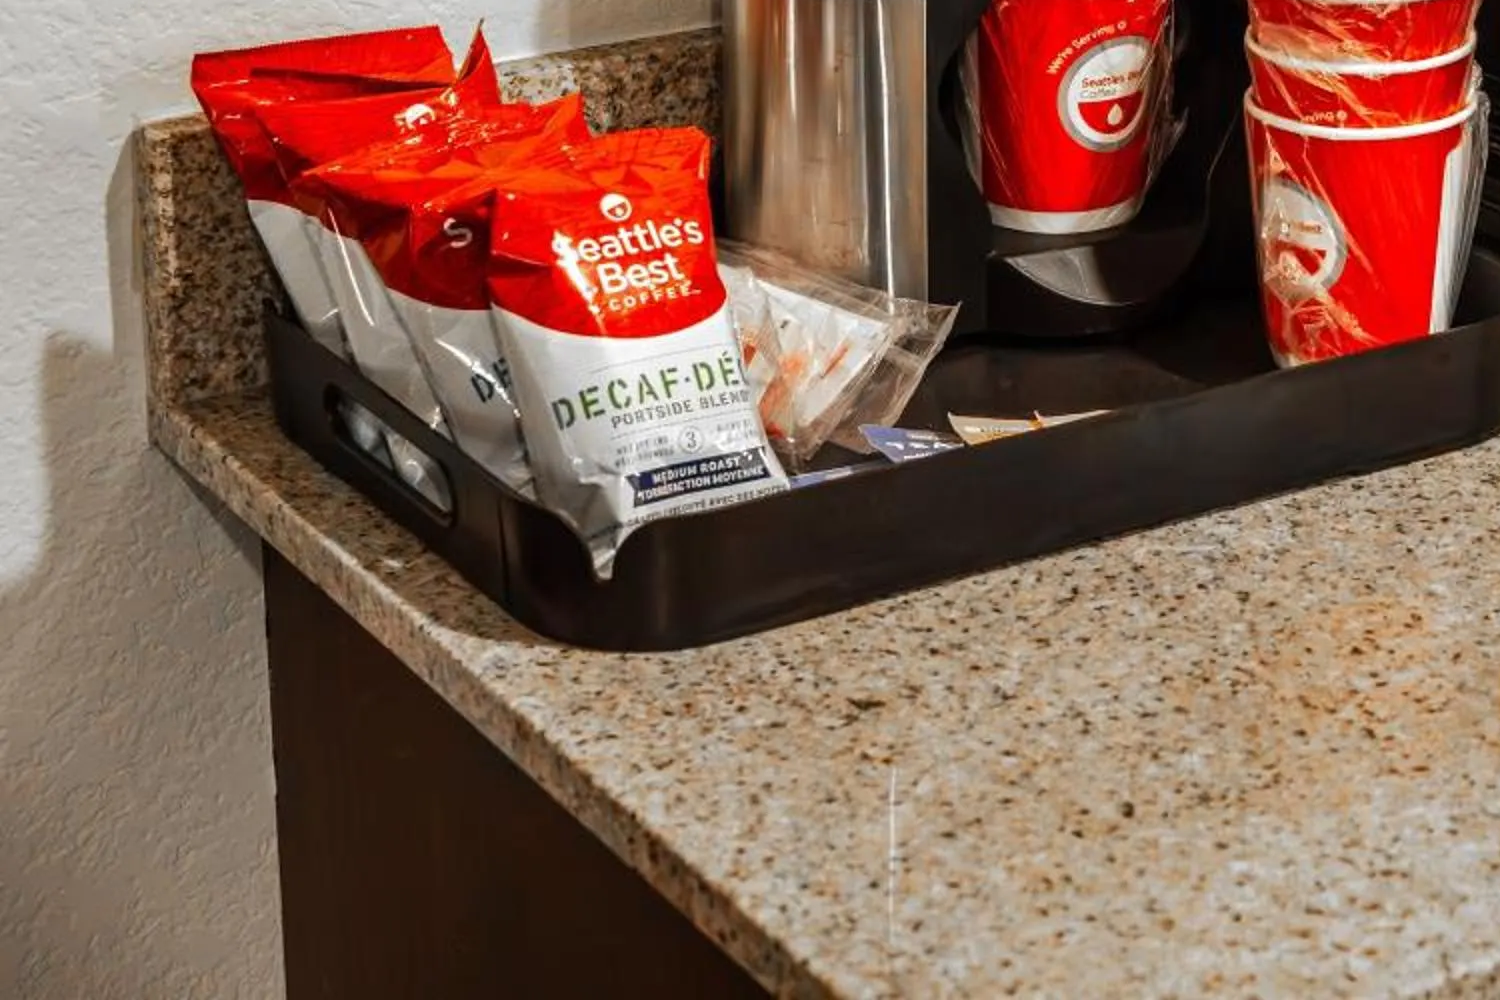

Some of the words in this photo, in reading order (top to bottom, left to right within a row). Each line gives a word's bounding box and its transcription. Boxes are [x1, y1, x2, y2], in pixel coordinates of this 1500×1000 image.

[597, 252, 686, 295] Best
[608, 279, 693, 311] COFFEE
[611, 399, 694, 429] PORTSIDE
[686, 431, 698, 449] 3
[652, 465, 698, 484] MEDIUM
[699, 455, 742, 474] ROAST
